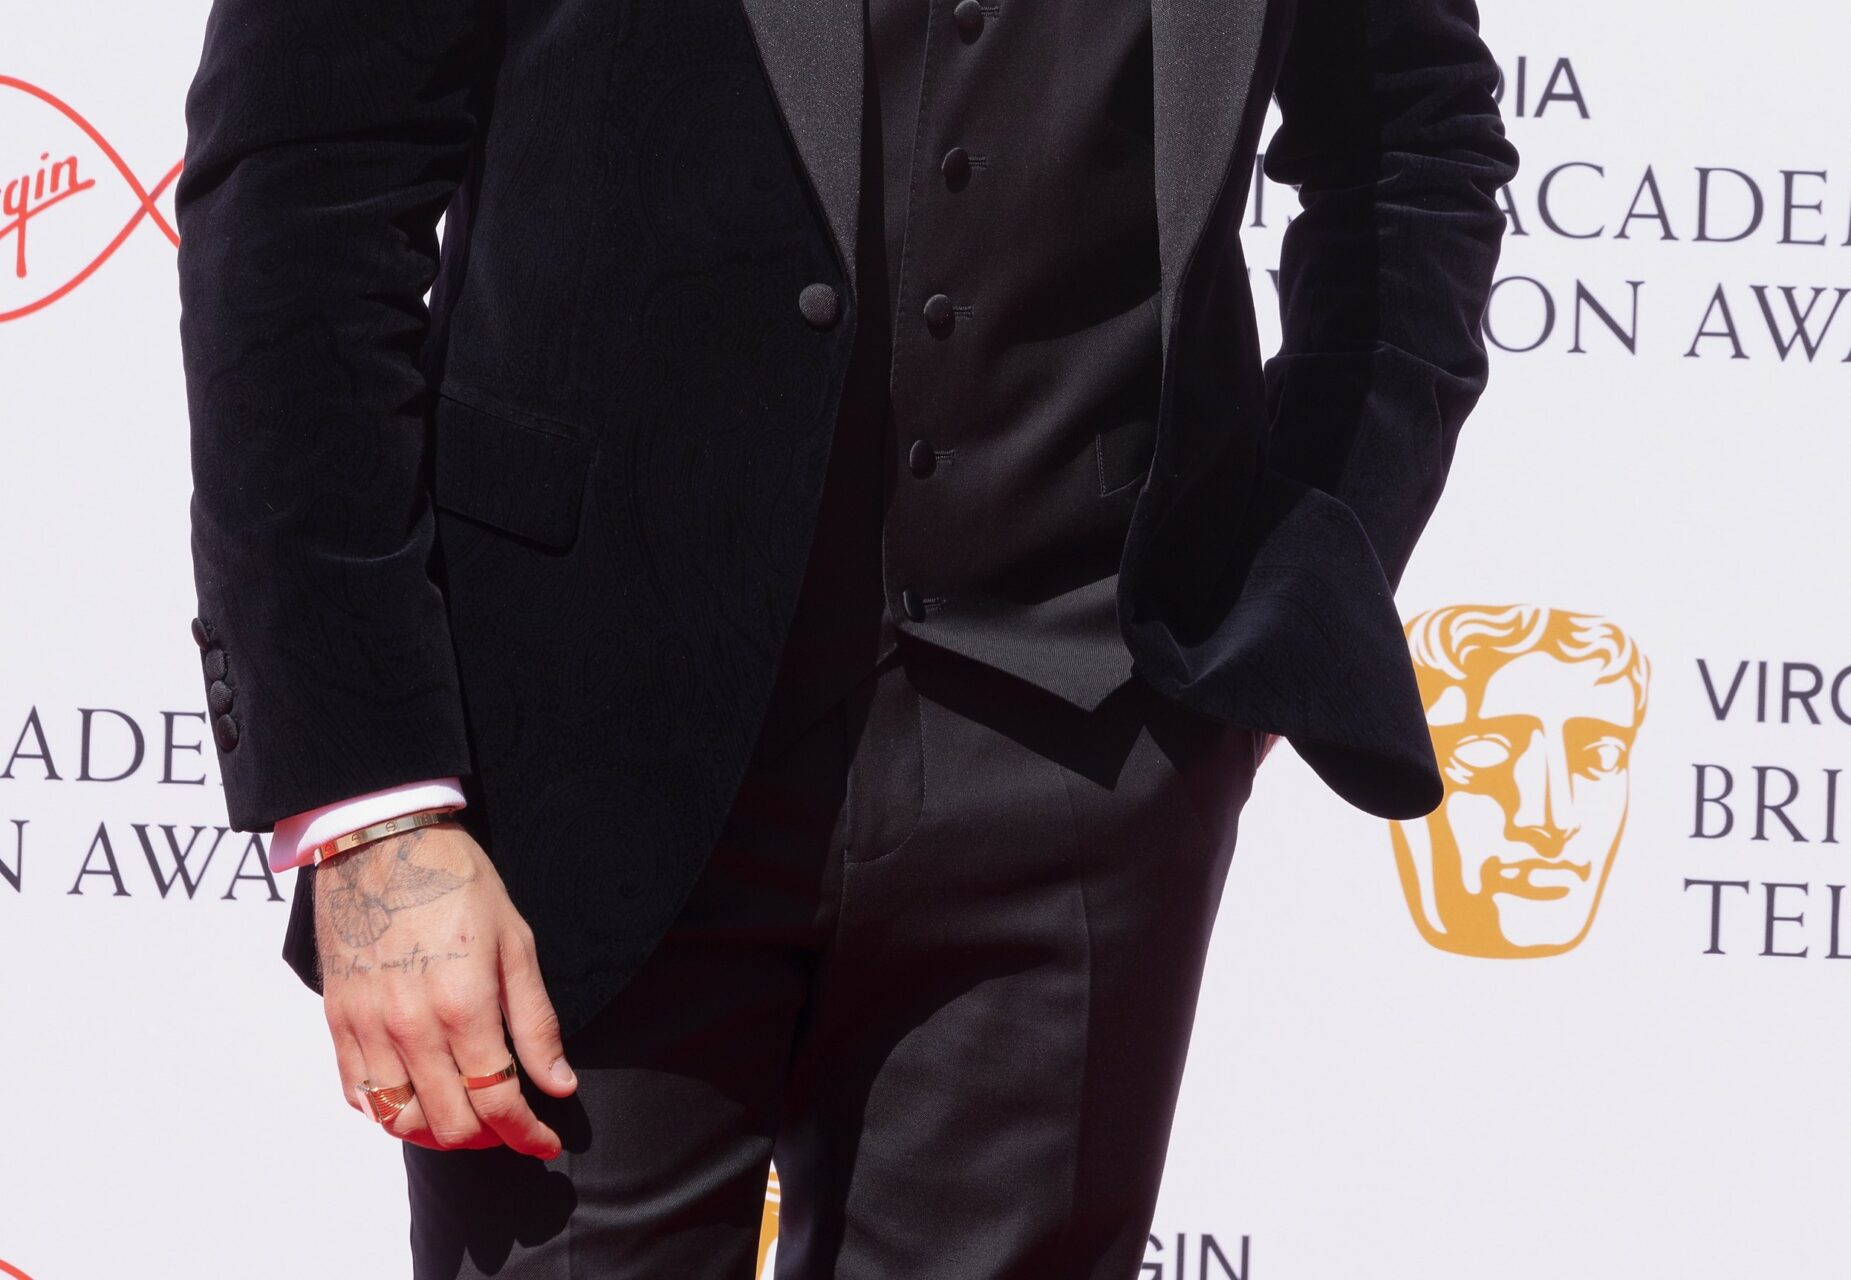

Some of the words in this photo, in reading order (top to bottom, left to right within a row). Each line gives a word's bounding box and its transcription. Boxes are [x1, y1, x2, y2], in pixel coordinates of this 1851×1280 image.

[1494, 56, 1591, 120] IA
[0, 152, 96, 279] gin
[1501, 161, 1851, 247] CADE
[1683, 282, 1851, 363] AW
[0, 705, 224, 788] ADE
[1688, 763, 1843, 844] BRI
[67, 821, 287, 902] AWA
